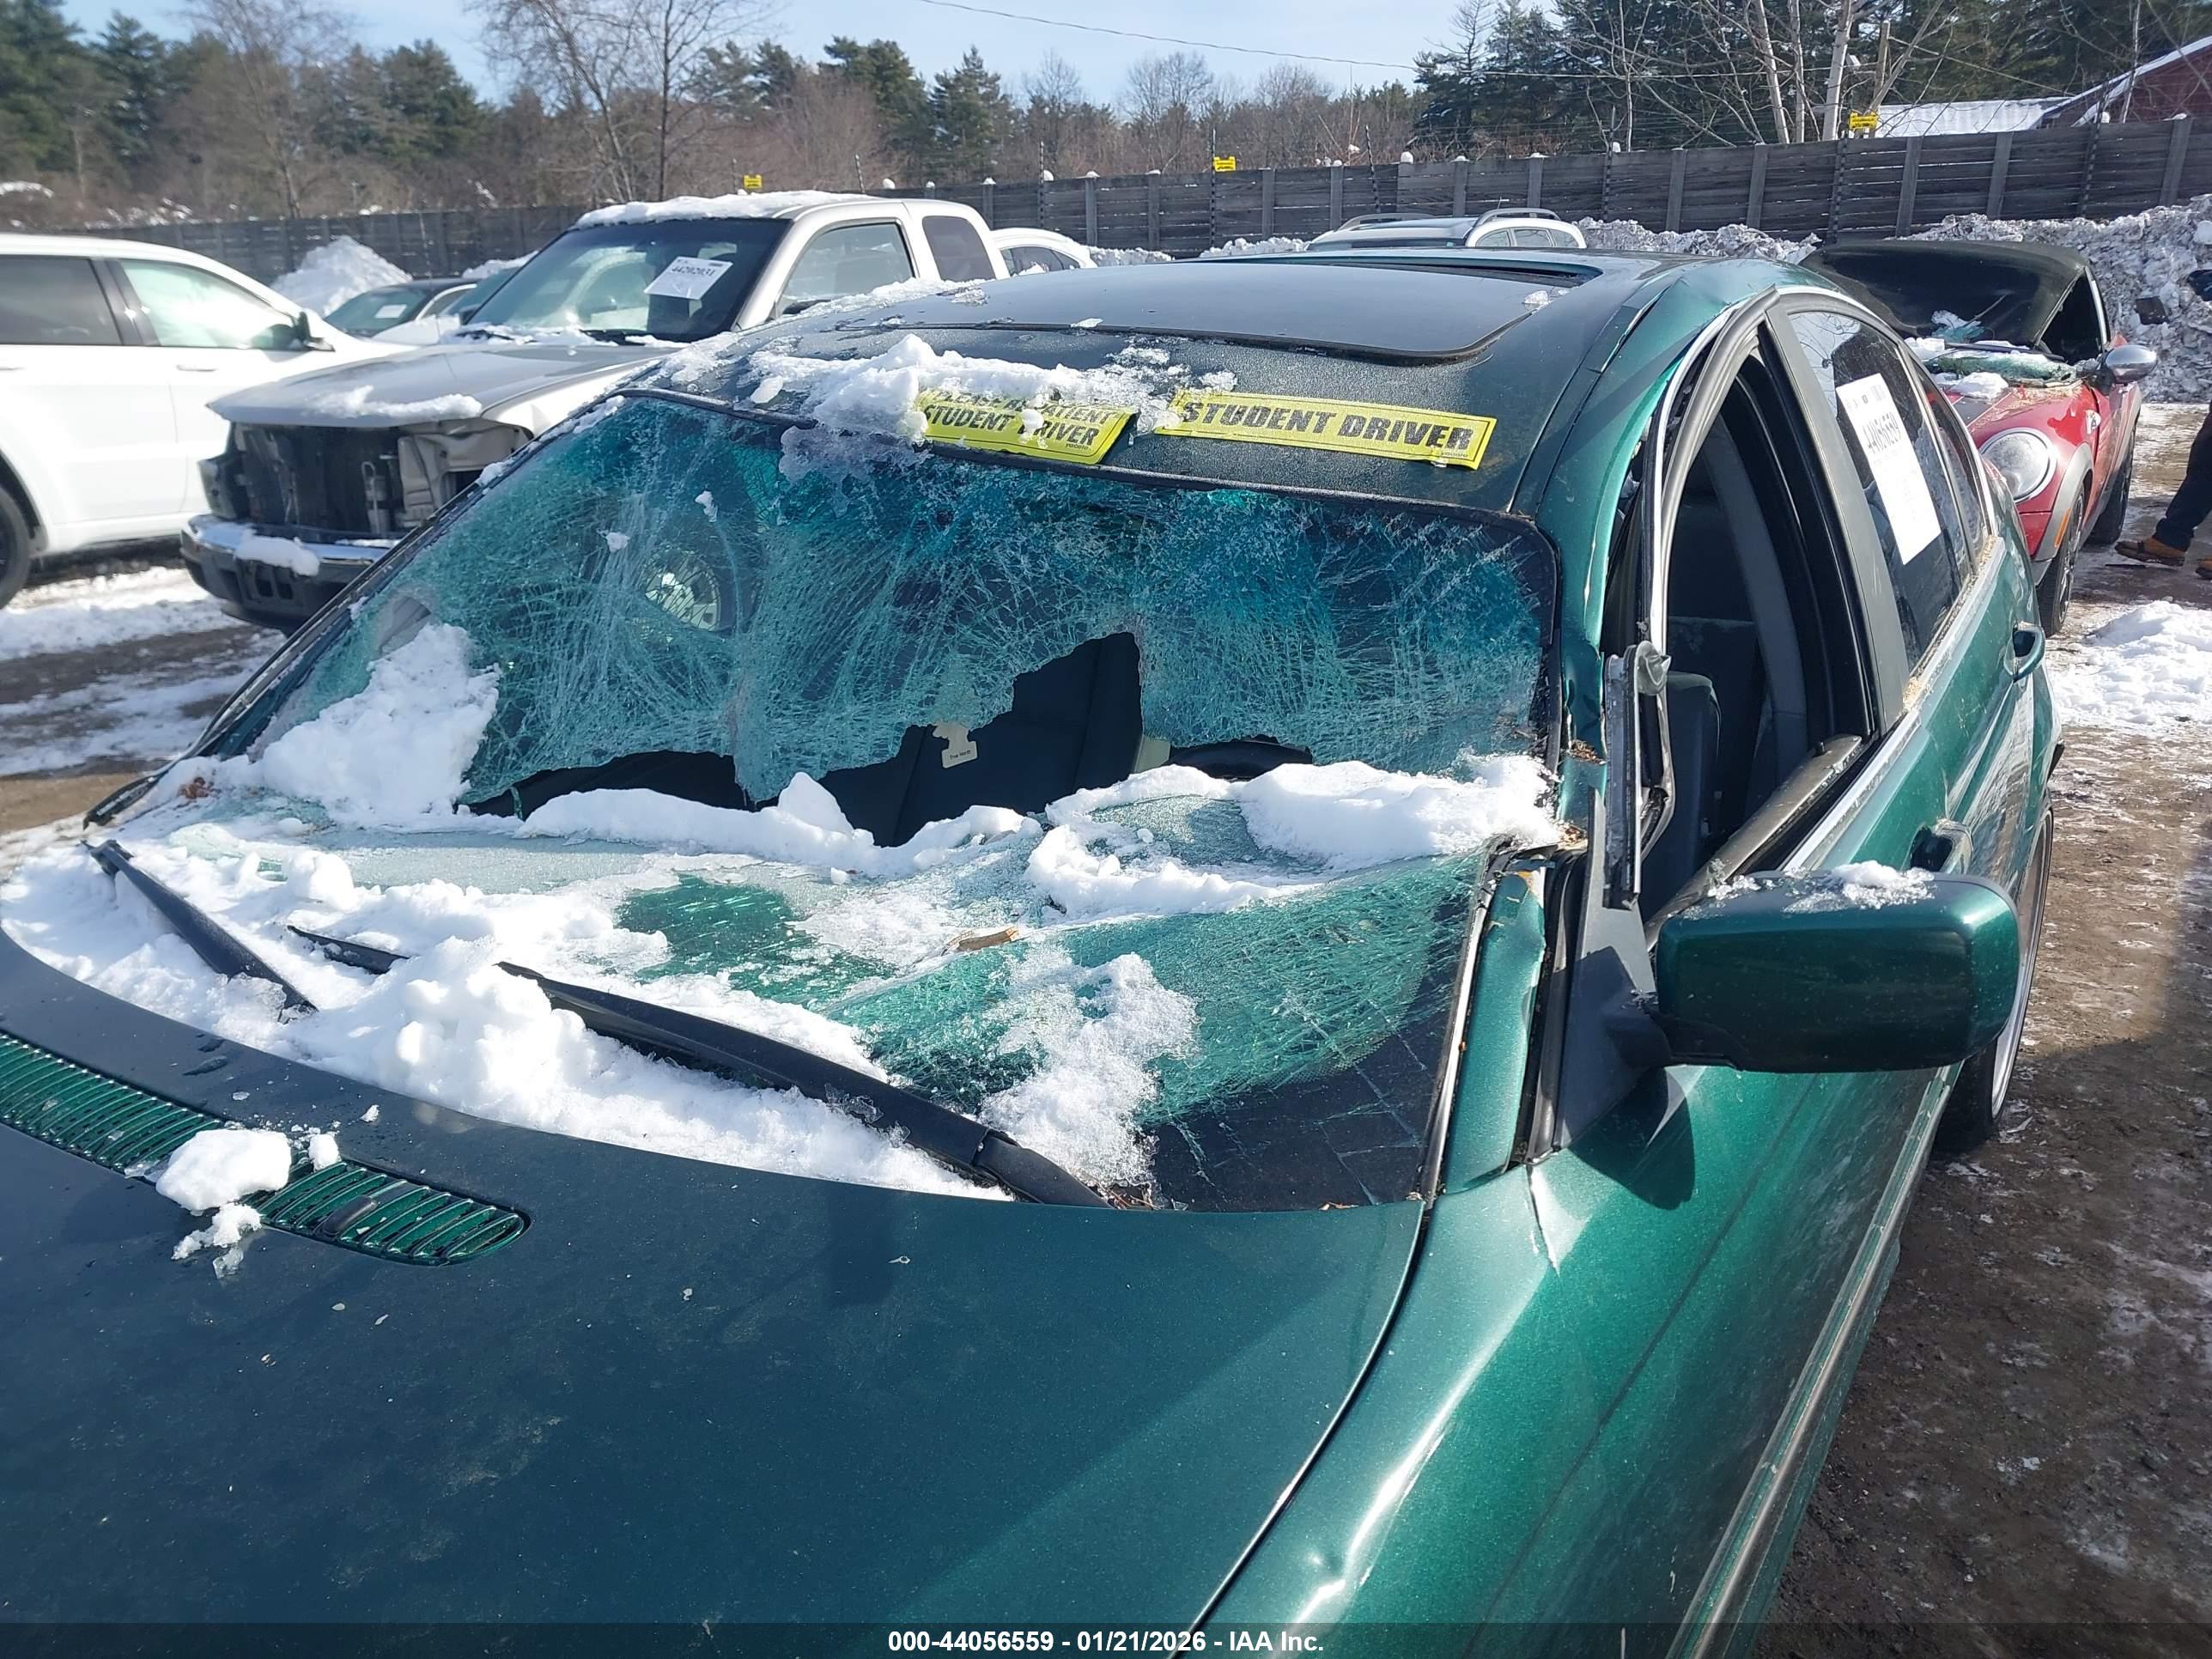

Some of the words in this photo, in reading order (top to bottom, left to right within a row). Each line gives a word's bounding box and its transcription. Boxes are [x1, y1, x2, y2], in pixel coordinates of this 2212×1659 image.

[924, 404, 1016, 431] STUDENT
[1018, 420, 1100, 446] RIVER
[1037, 404, 1116, 424] ATIENT
[1182, 402, 1337, 434] STUDENT
[1338, 414, 1474, 450] DRIVER
